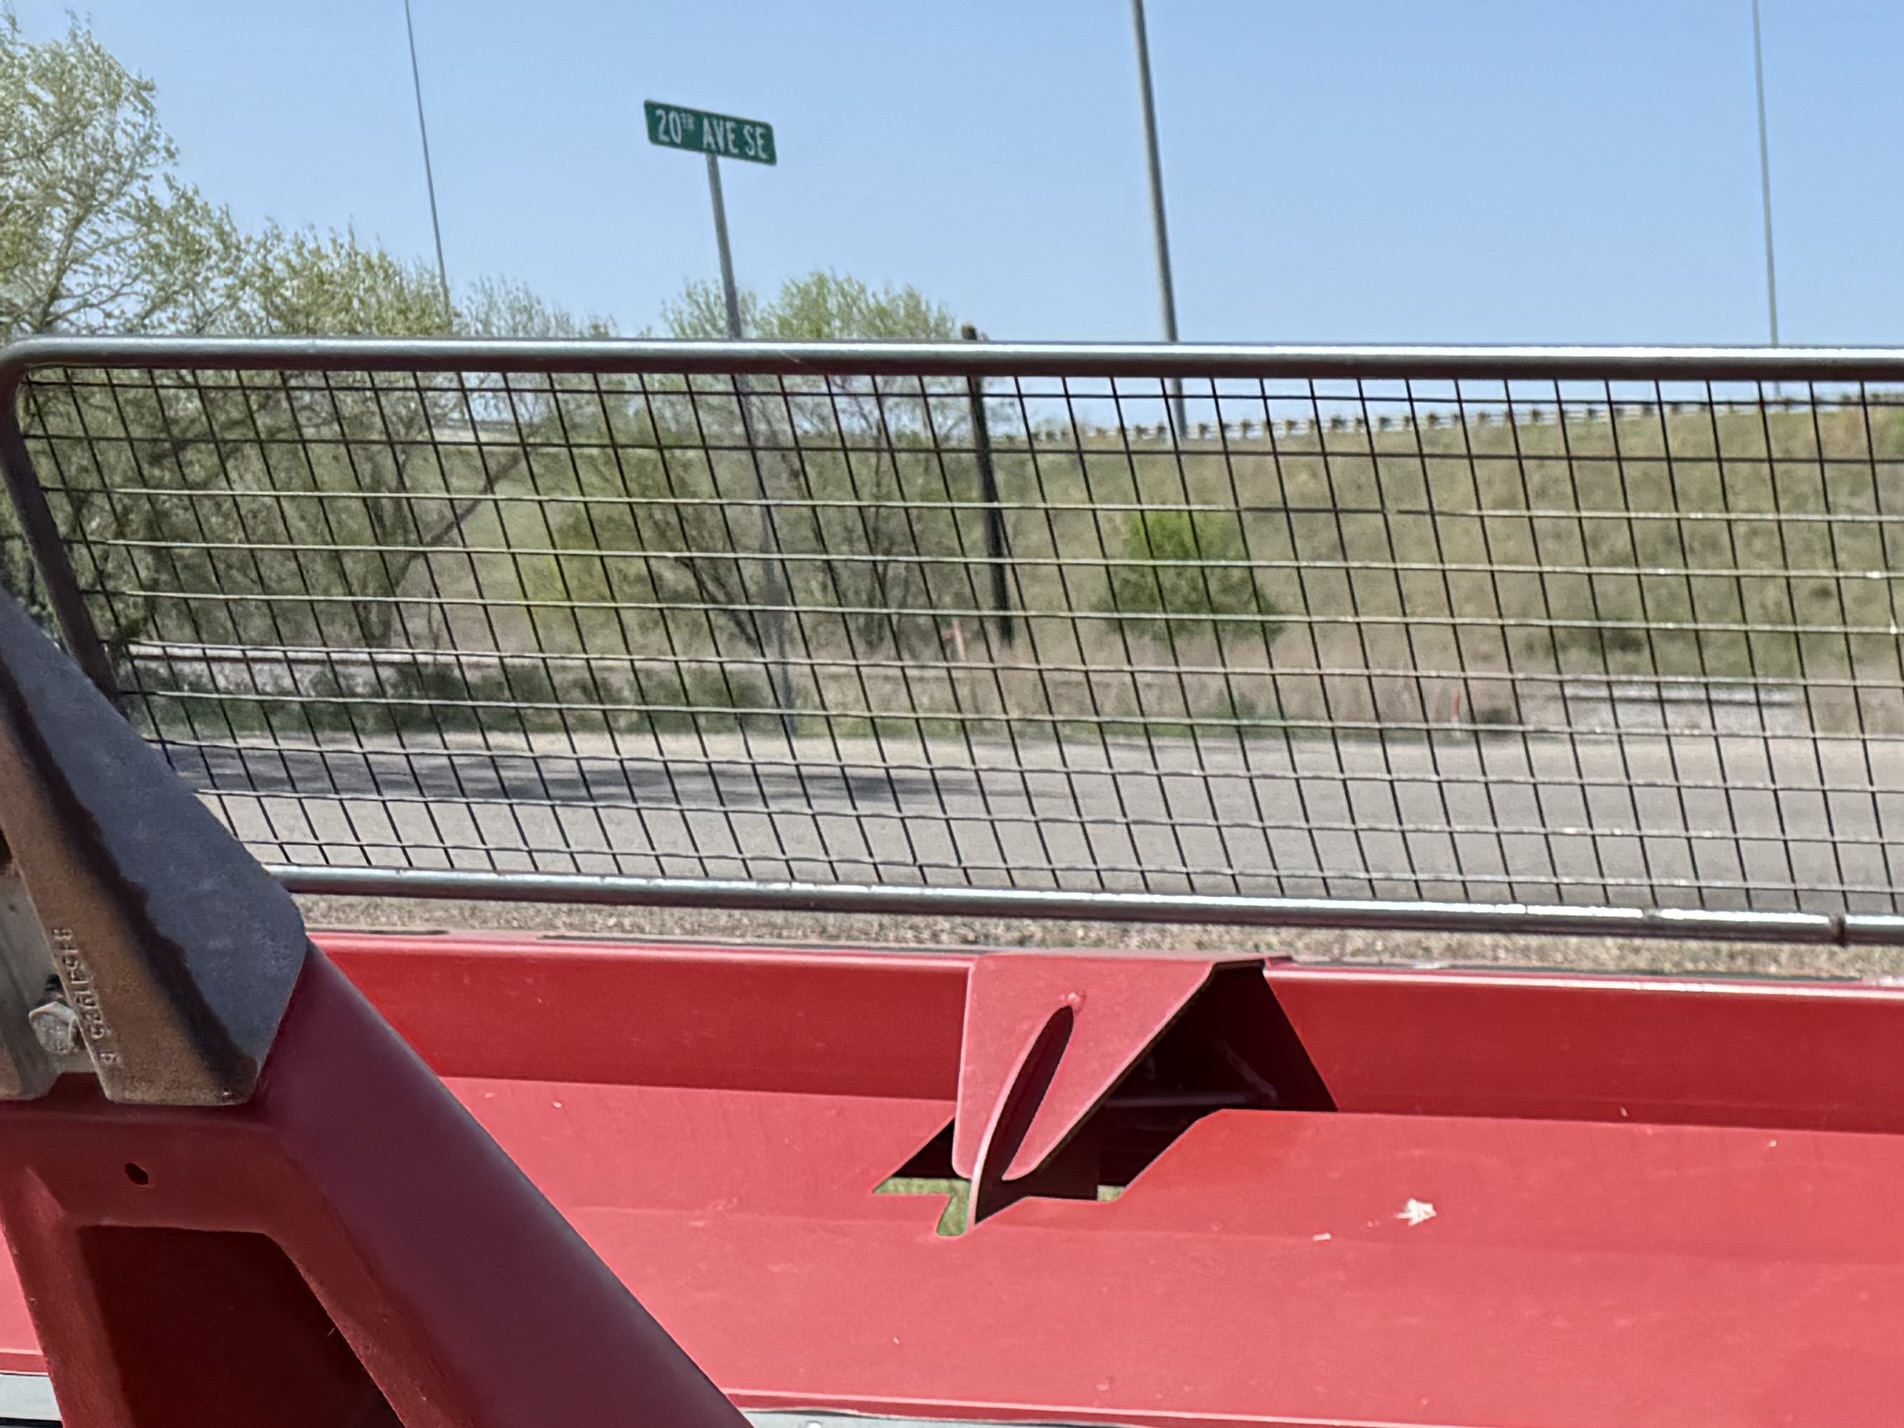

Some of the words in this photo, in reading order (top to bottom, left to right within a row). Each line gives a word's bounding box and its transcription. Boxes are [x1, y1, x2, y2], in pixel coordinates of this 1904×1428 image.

[655, 108, 695, 145] 20TH
[702, 117, 739, 154] AVE
[743, 124, 769, 160] SE
